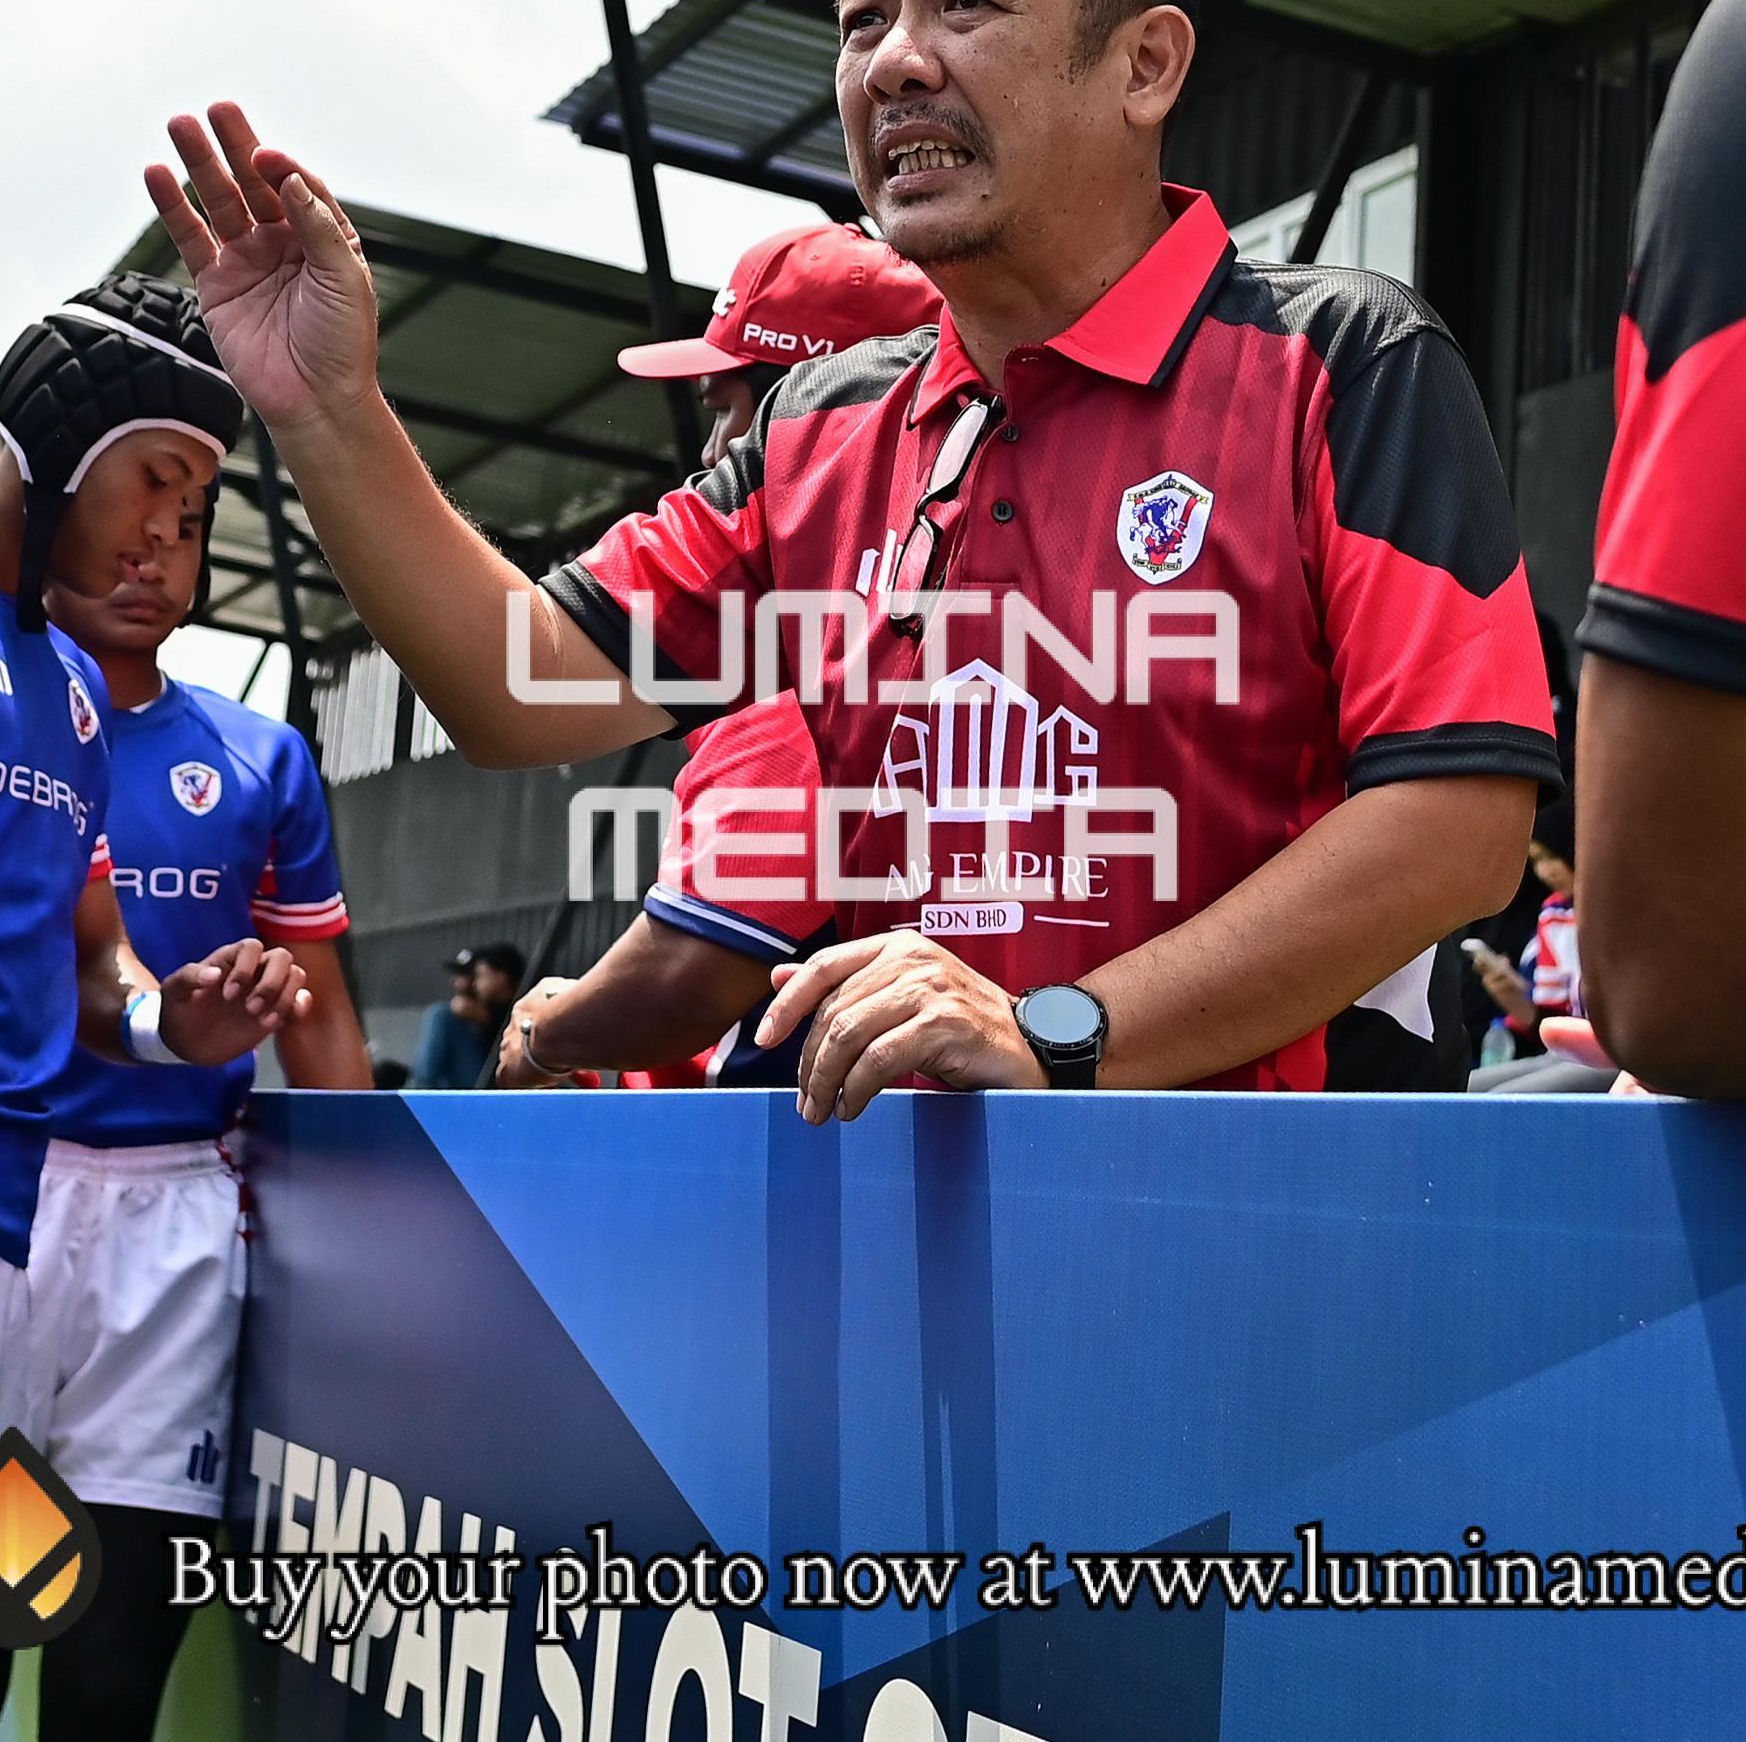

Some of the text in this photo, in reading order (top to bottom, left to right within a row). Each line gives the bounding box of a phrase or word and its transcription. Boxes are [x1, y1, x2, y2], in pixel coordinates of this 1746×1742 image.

[743, 322, 798, 351] PRO
[949, 851, 1109, 899] EMPIRE
[924, 908, 1007, 929] SDN BHD
[245, 1427, 517, 1741] TEMPAH
